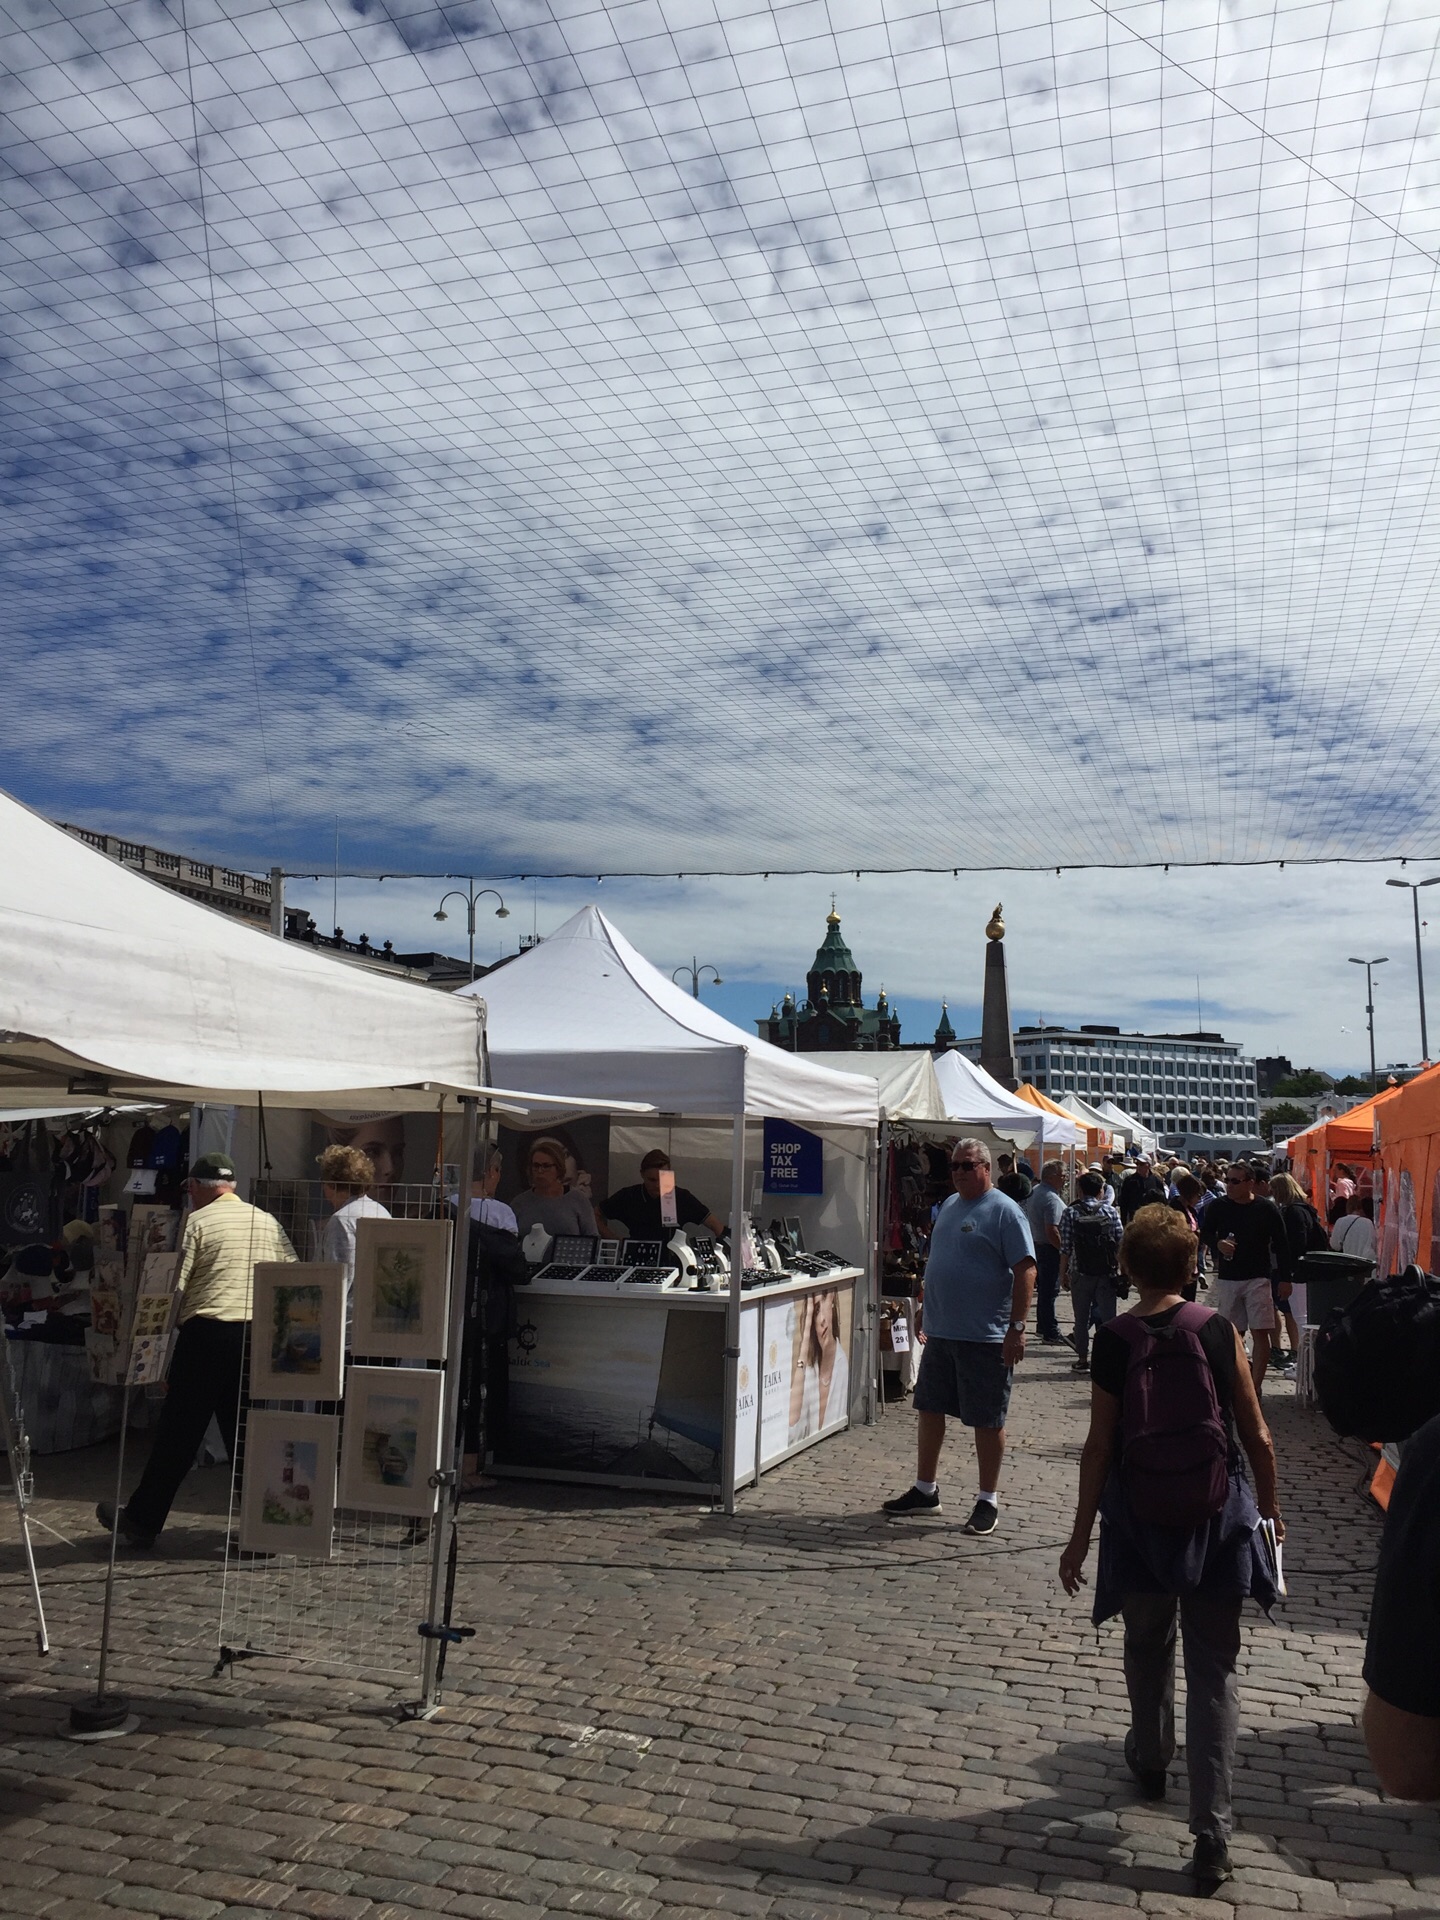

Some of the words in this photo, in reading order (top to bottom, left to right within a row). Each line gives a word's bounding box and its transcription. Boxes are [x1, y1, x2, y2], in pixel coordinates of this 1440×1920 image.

[770, 1143, 801, 1154] SHOP
[770, 1155, 793, 1166] TAX
[770, 1168, 799, 1178] FREE
[534, 1359, 551, 1368] Sea
[763, 1370, 782, 1389] TAIKA
